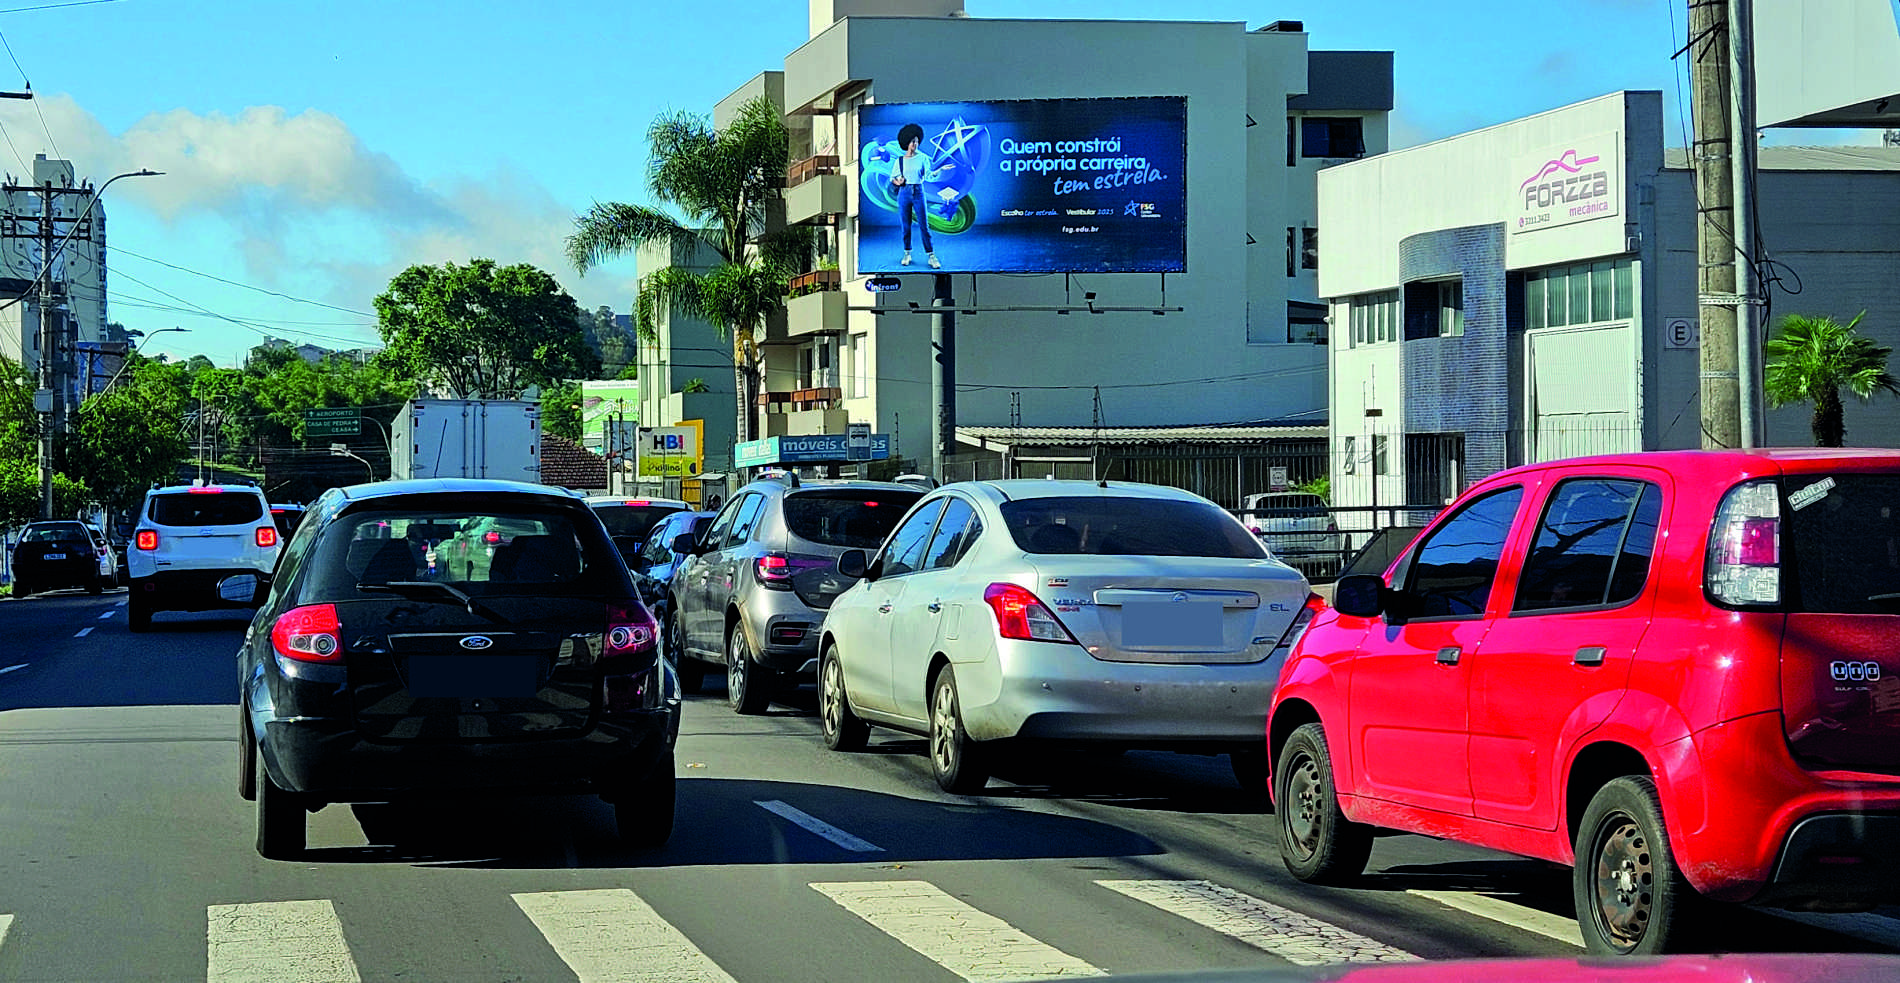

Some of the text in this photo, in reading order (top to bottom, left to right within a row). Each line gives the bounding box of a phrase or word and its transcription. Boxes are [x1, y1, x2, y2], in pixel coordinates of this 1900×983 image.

[1000, 137, 1121, 154] Quem constrói
[1000, 159, 1012, 171] a
[1015, 155, 1076, 176] própria
[1053, 162, 1168, 196] tem estrela.
[1065, 208, 1096, 216] Vestibular
[1569, 200, 1609, 217] mecânica
[1062, 226, 1099, 234] fsg.edu.br
[1675, 326, 1686, 341] E
[653, 434, 684, 450] HBI
[782, 437, 837, 451] móveis
[1270, 603, 1289, 611] EL
